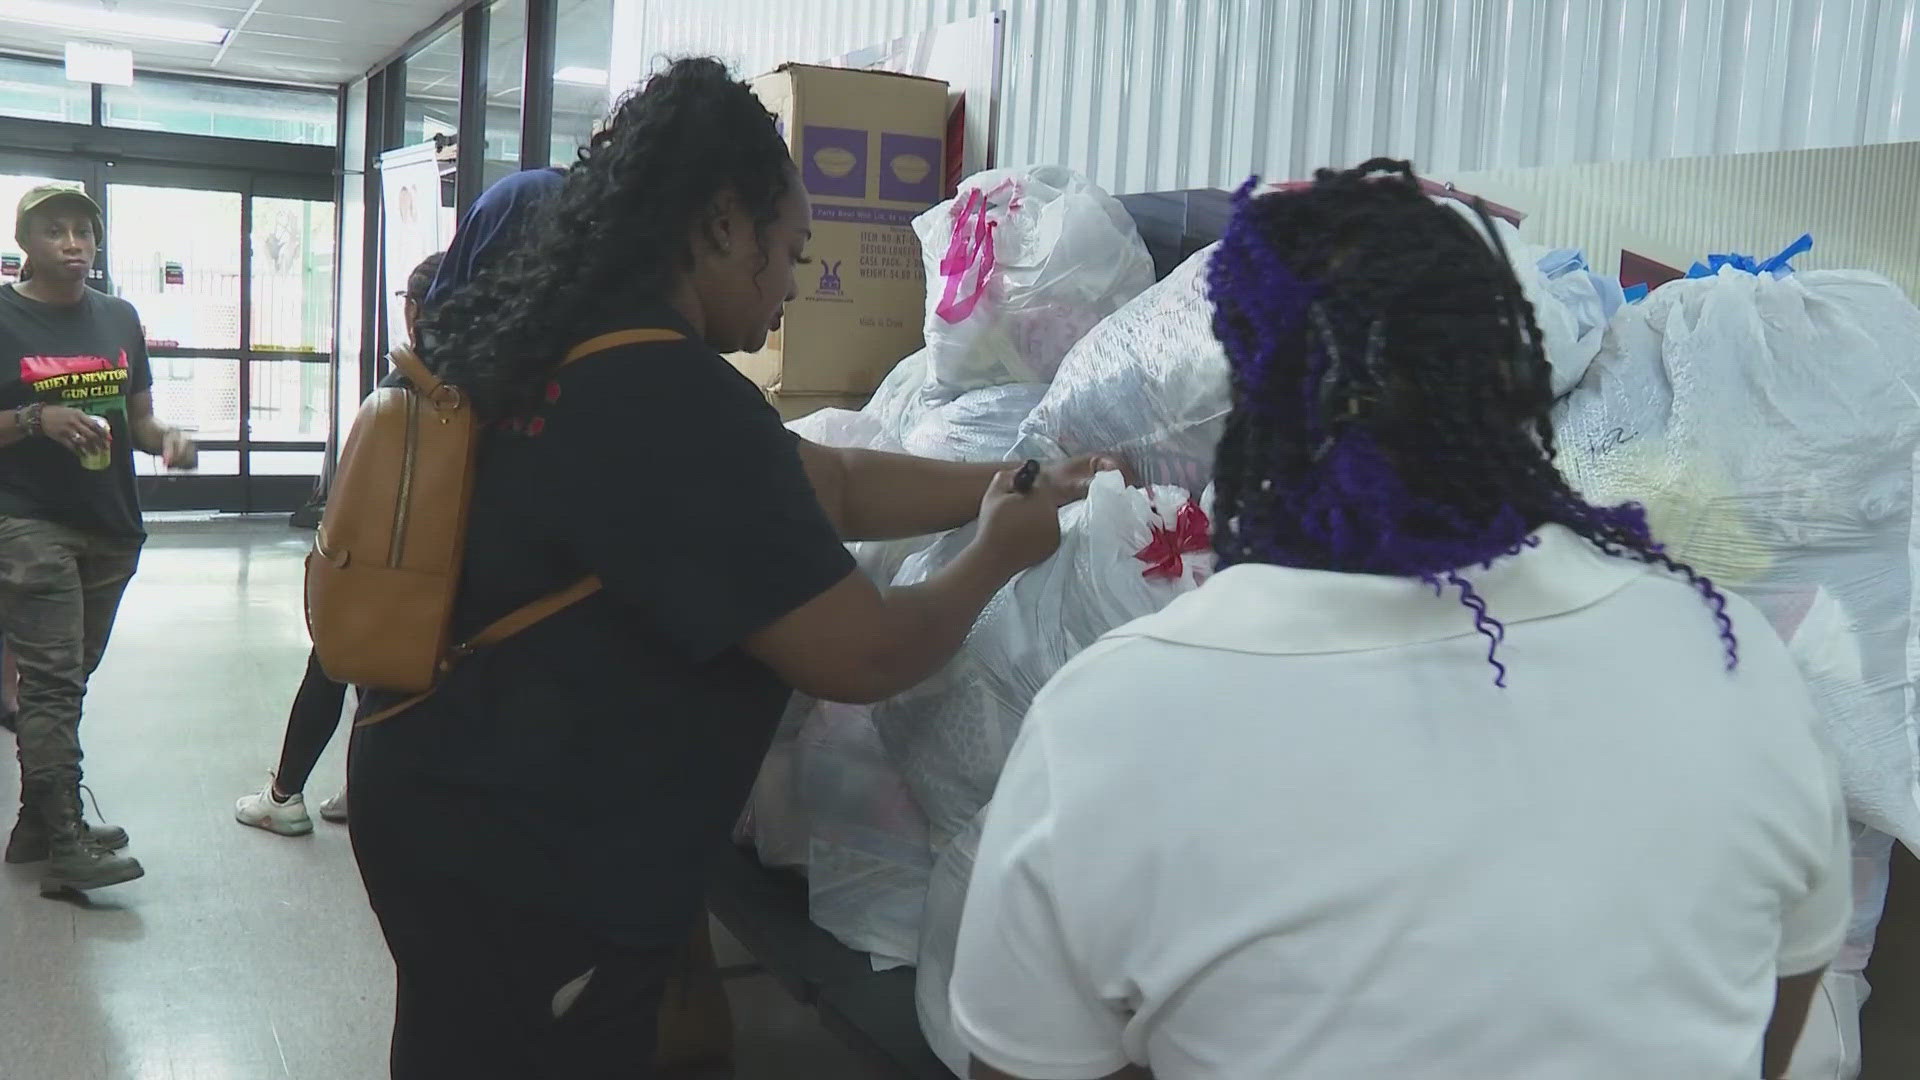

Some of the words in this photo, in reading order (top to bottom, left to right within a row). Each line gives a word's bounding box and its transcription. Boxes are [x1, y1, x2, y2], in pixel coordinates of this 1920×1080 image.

[860, 256, 878, 266] CASE
[33, 375, 70, 392] HUEY
[71, 374, 80, 385] P
[81, 368, 129, 384] NEWTON
[62, 387, 89, 399] GUN
[90, 384, 120, 397] CLUB
